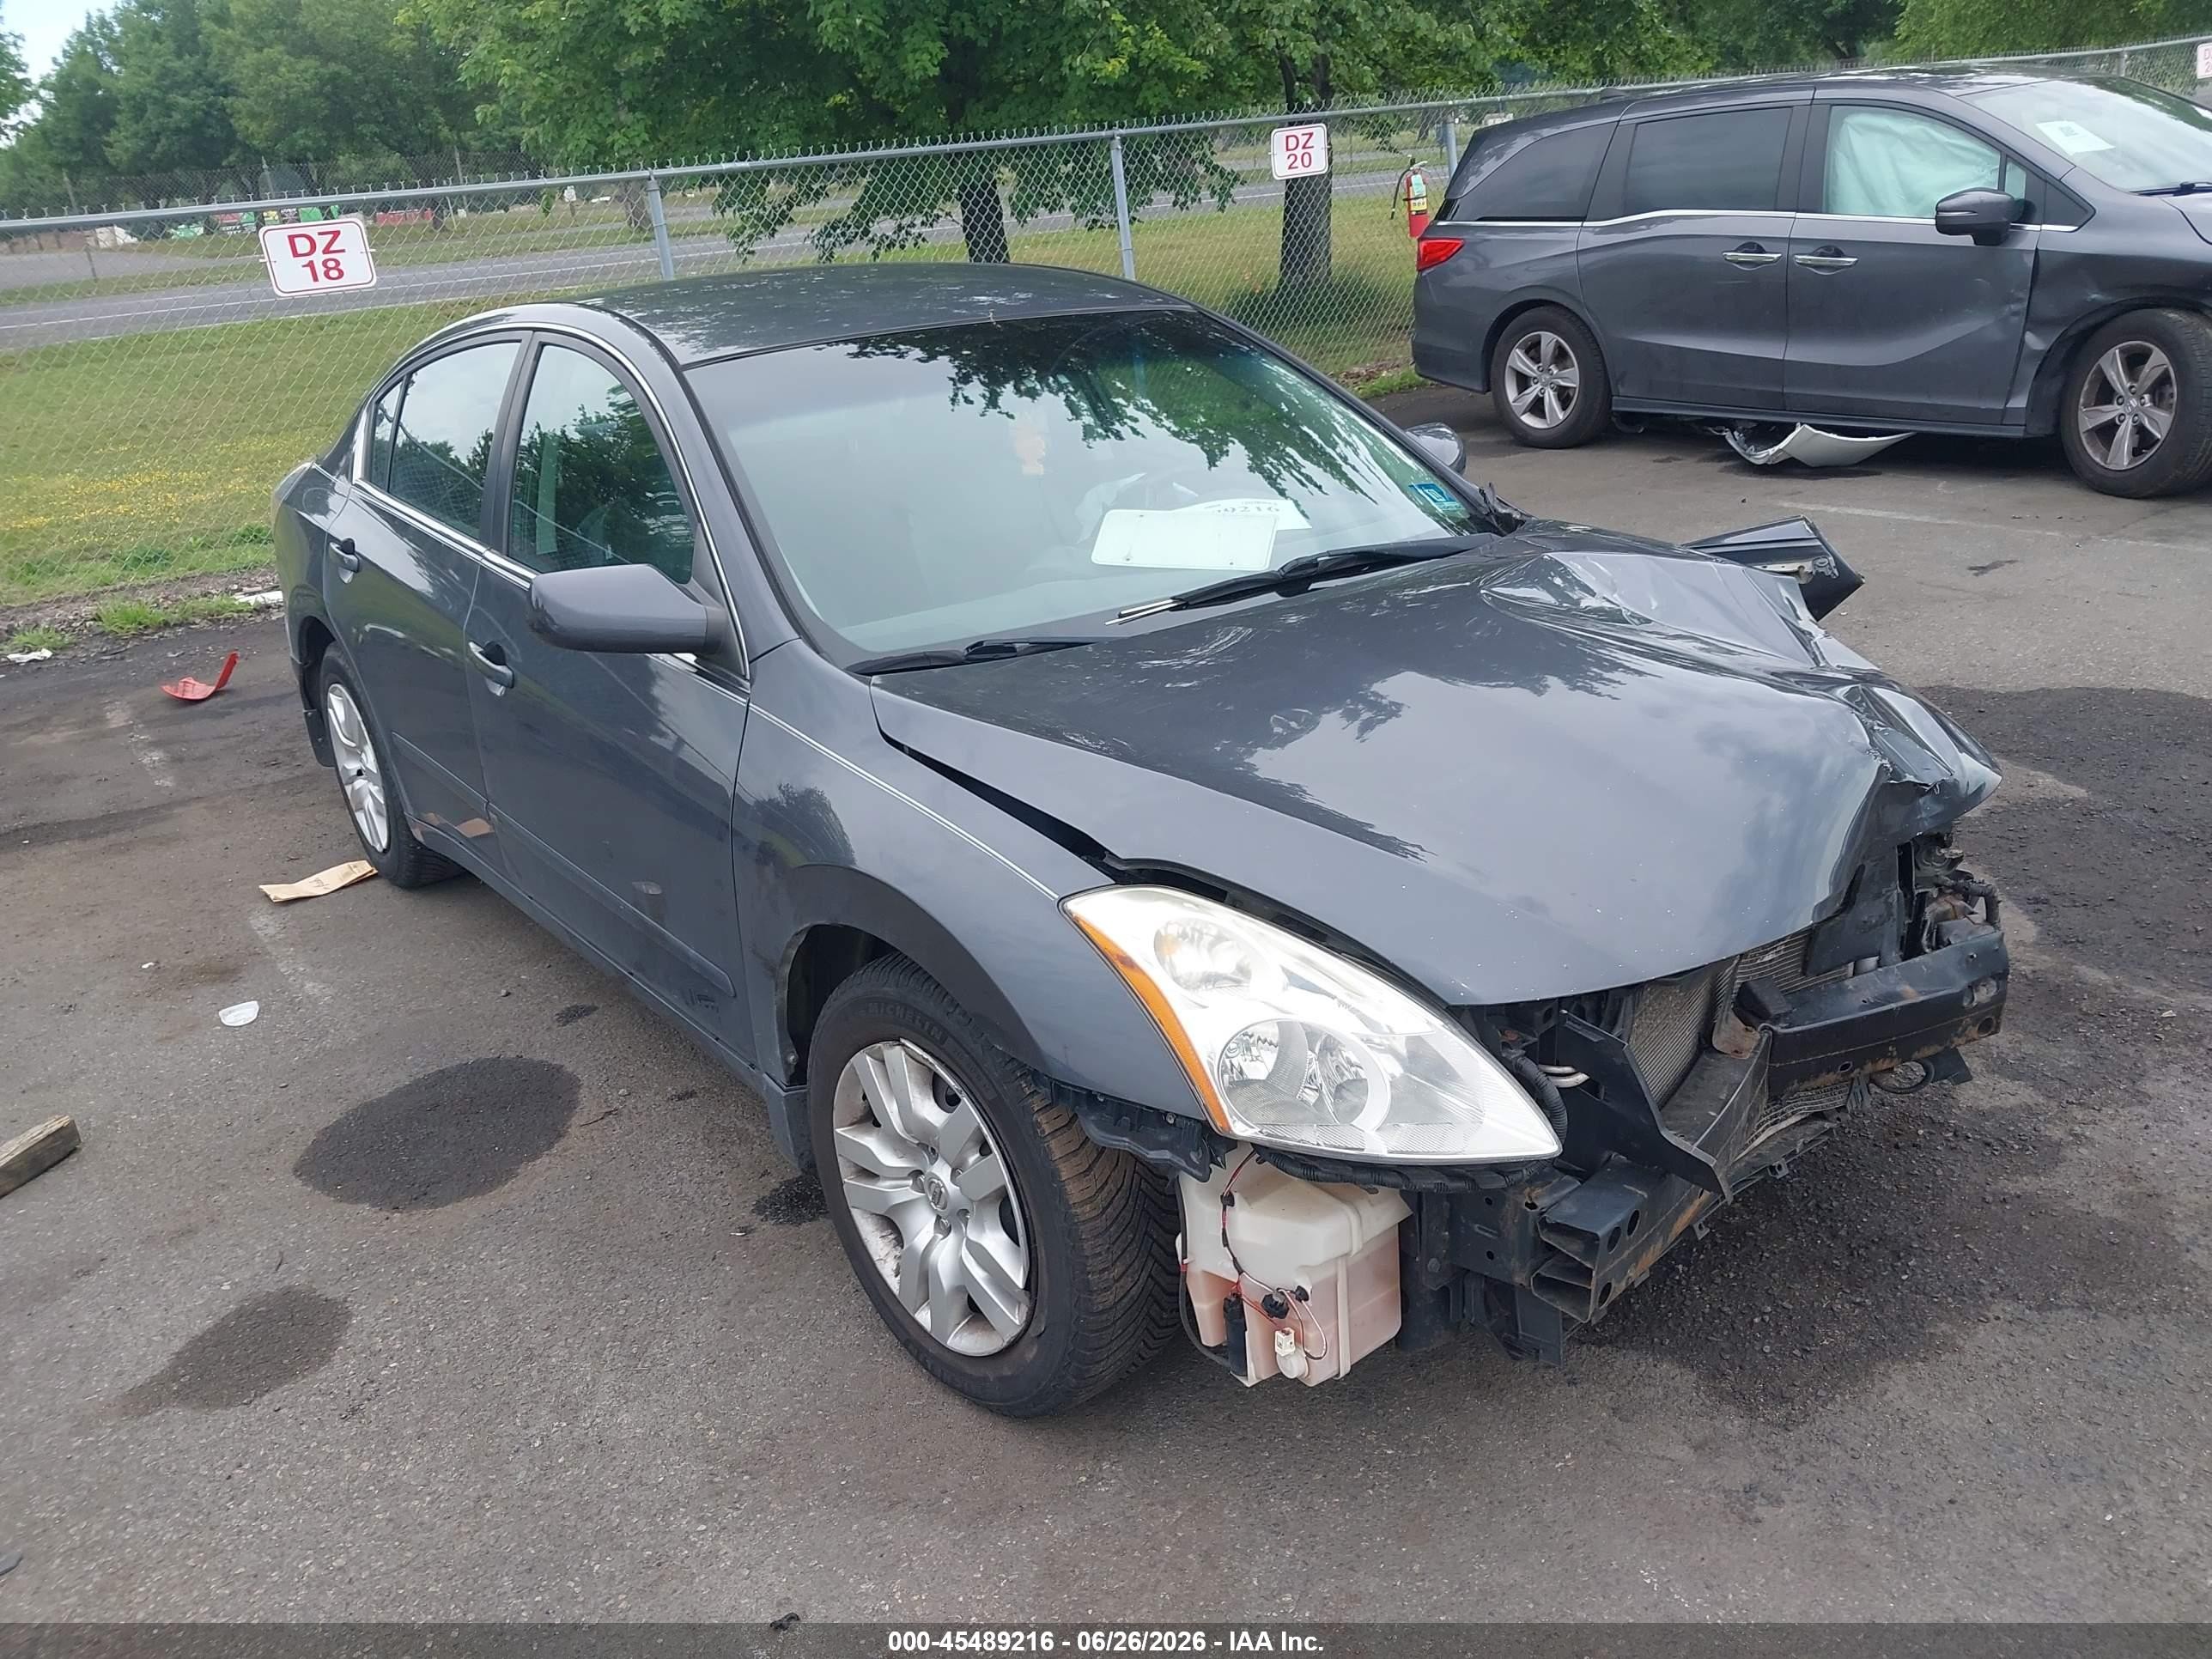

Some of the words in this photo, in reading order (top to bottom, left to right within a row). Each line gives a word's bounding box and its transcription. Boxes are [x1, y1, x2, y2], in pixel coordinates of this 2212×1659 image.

[1285, 131, 1315, 152] DZ
[1286, 152, 1312, 170] 20
[287, 229, 346, 258] DZ
[301, 258, 344, 283] 18
